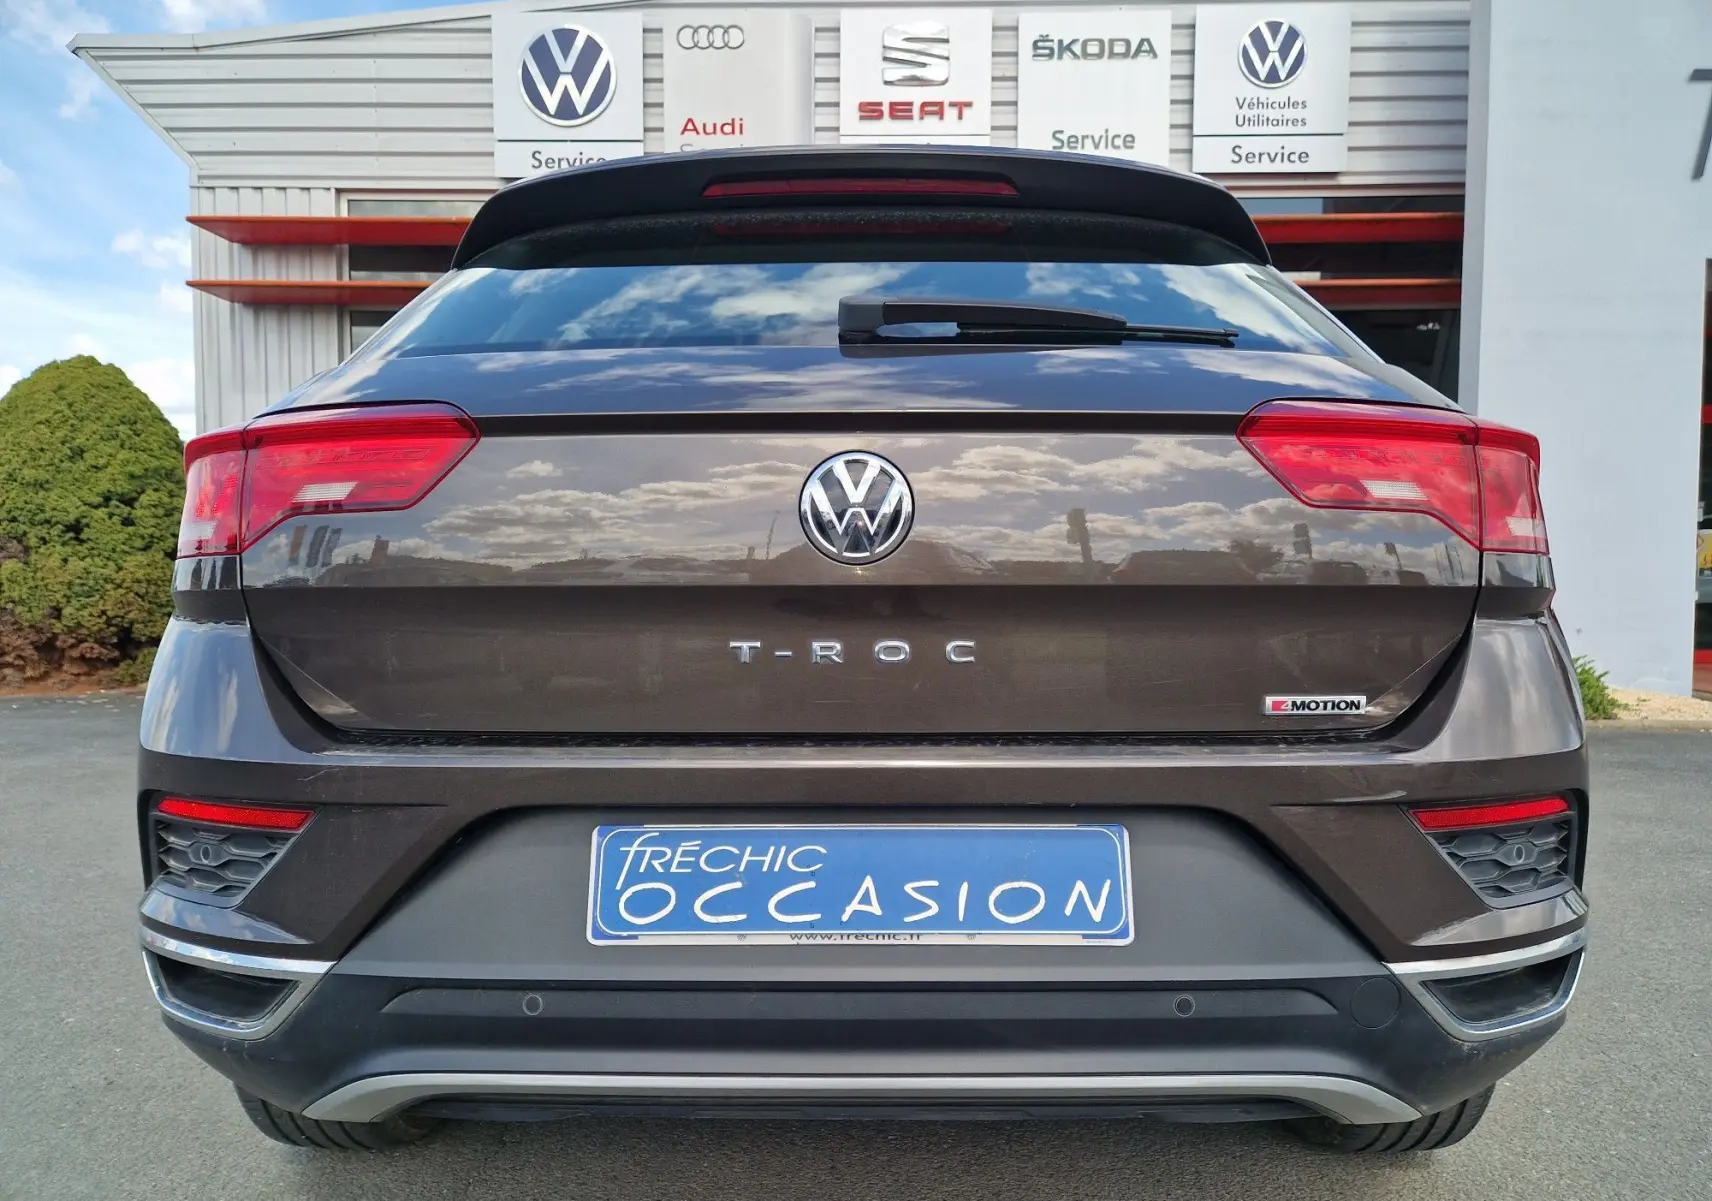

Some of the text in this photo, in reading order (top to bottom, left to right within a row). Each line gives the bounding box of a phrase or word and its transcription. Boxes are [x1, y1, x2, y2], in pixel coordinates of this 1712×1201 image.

[1032, 34, 1158, 61] ŠKODA
[858, 101, 973, 121] SEAT
[1236, 96, 1307, 110] Véhicules
[680, 118, 744, 136] Audi
[1235, 114, 1307, 127] Utilitaires
[1051, 129, 1135, 150] Service
[1231, 145, 1310, 164] Service
[618, 875, 1112, 925] OCCASION
